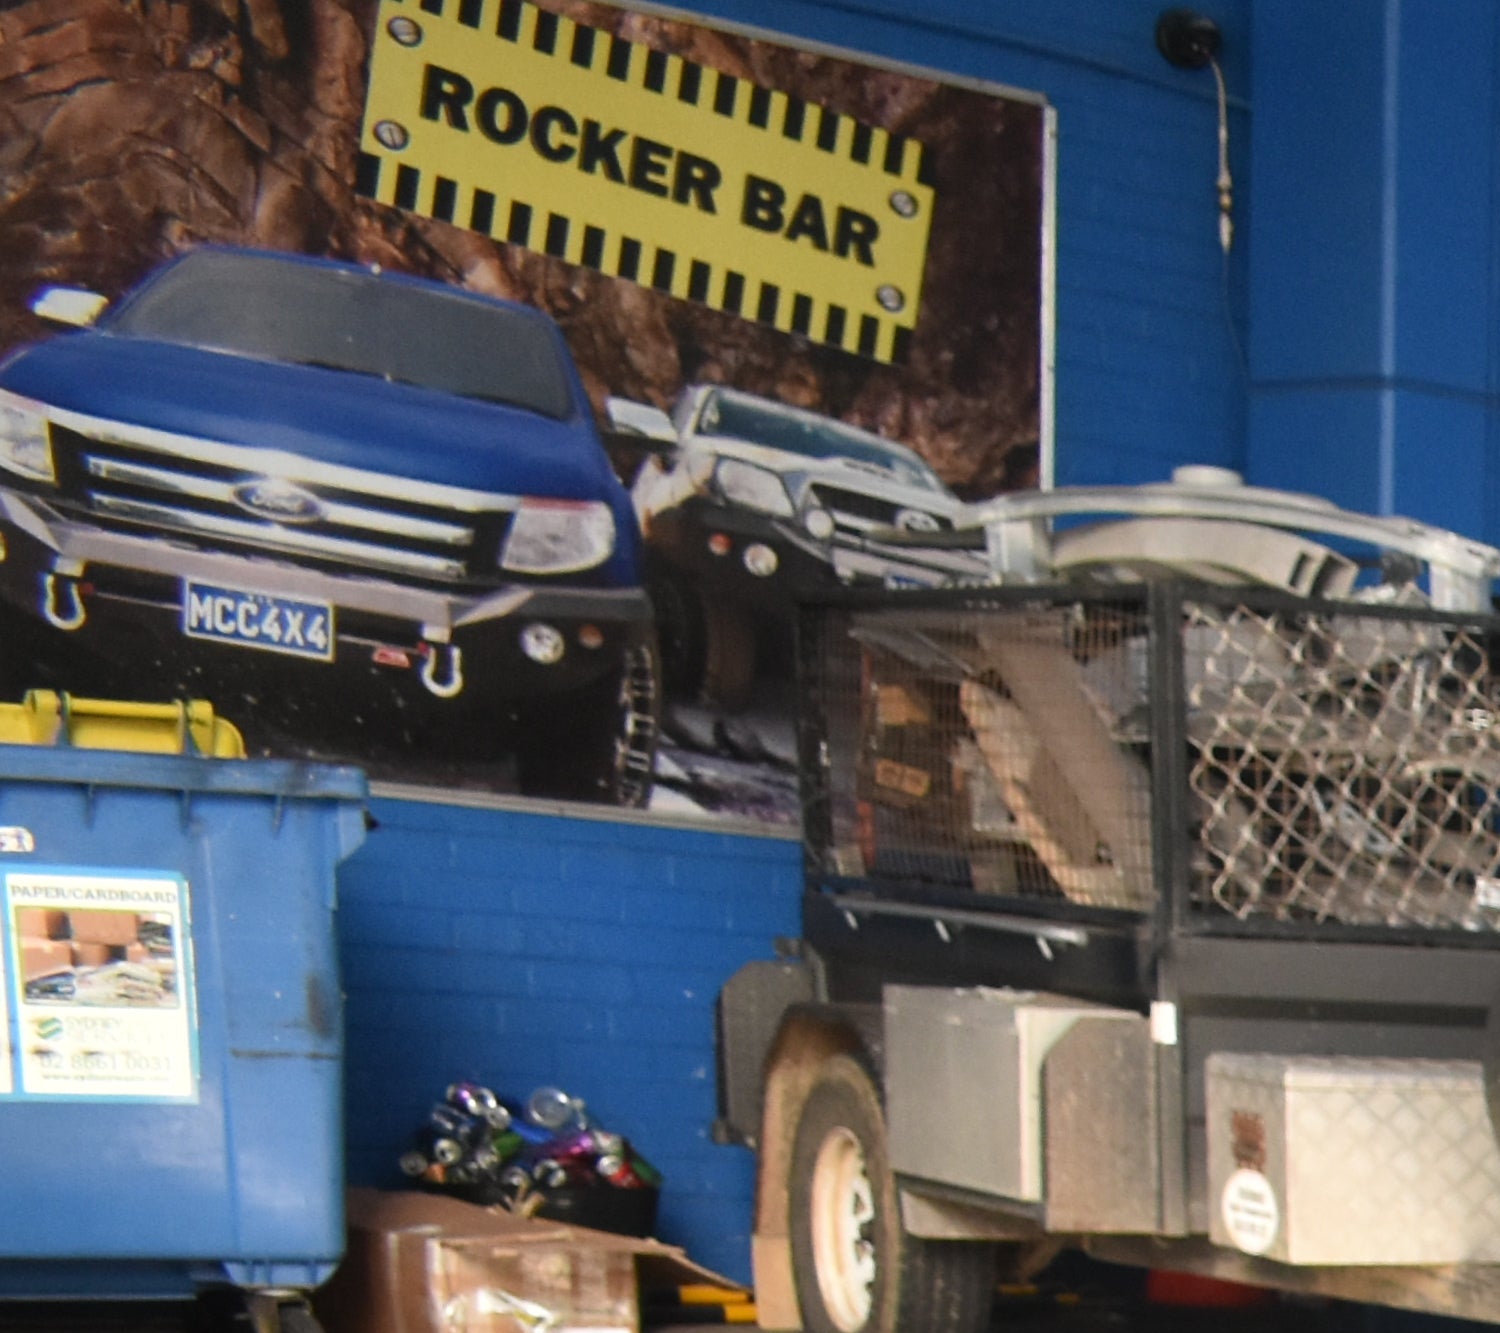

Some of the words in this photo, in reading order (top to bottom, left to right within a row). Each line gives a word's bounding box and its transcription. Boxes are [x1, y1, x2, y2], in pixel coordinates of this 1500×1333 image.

[419, 62, 722, 215] ROCKER
[740, 173, 880, 267] BAR
[190, 592, 328, 649] MCC4X4
[11, 885, 178, 903] PAPER/CARDBOARD
